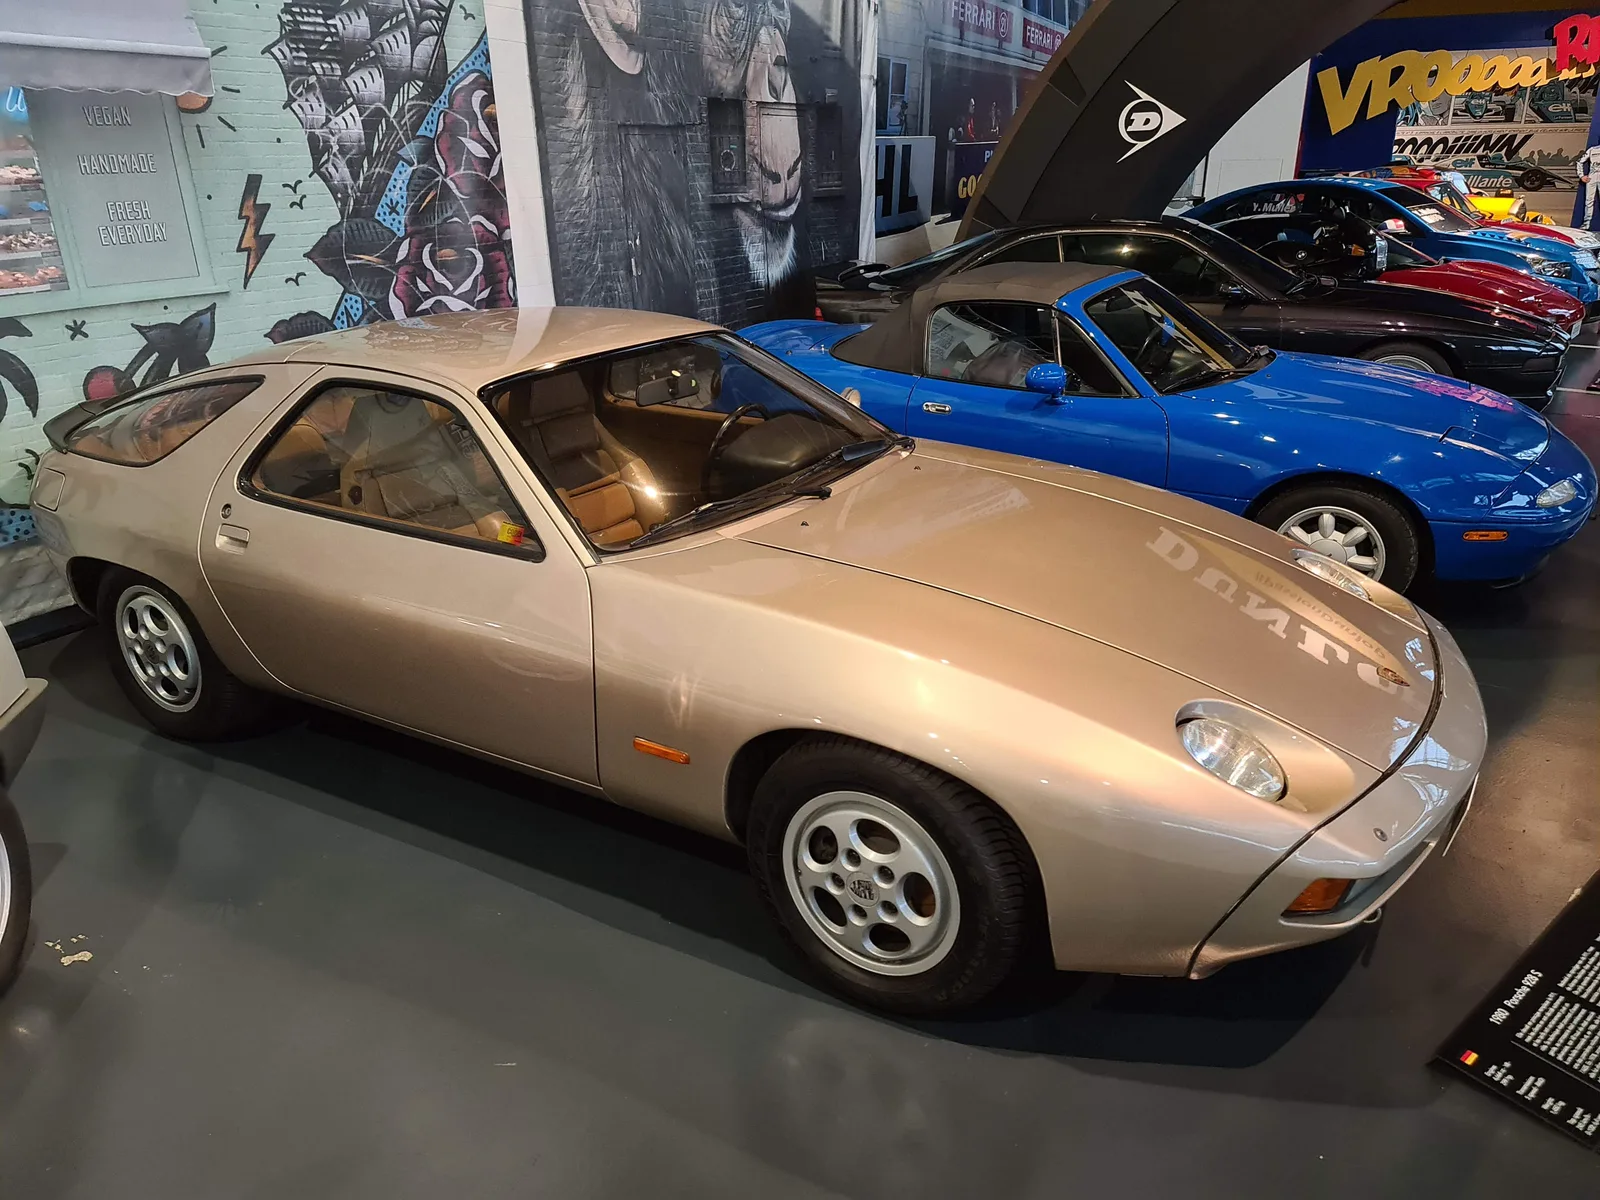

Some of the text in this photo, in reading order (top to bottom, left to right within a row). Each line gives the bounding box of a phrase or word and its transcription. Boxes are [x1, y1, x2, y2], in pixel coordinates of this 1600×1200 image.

[951, 0, 995, 31] FERRARI
[1026, 25, 1053, 50] FERRARI
[82, 105, 131, 127] VEGAN
[77, 153, 157, 175] HANDMADE
[106, 200, 151, 222] FRESH
[98, 222, 167, 246] EVERYDAY
[1489, 1007, 1510, 1025] 1980
[1503, 985, 1531, 1009] Porsche
